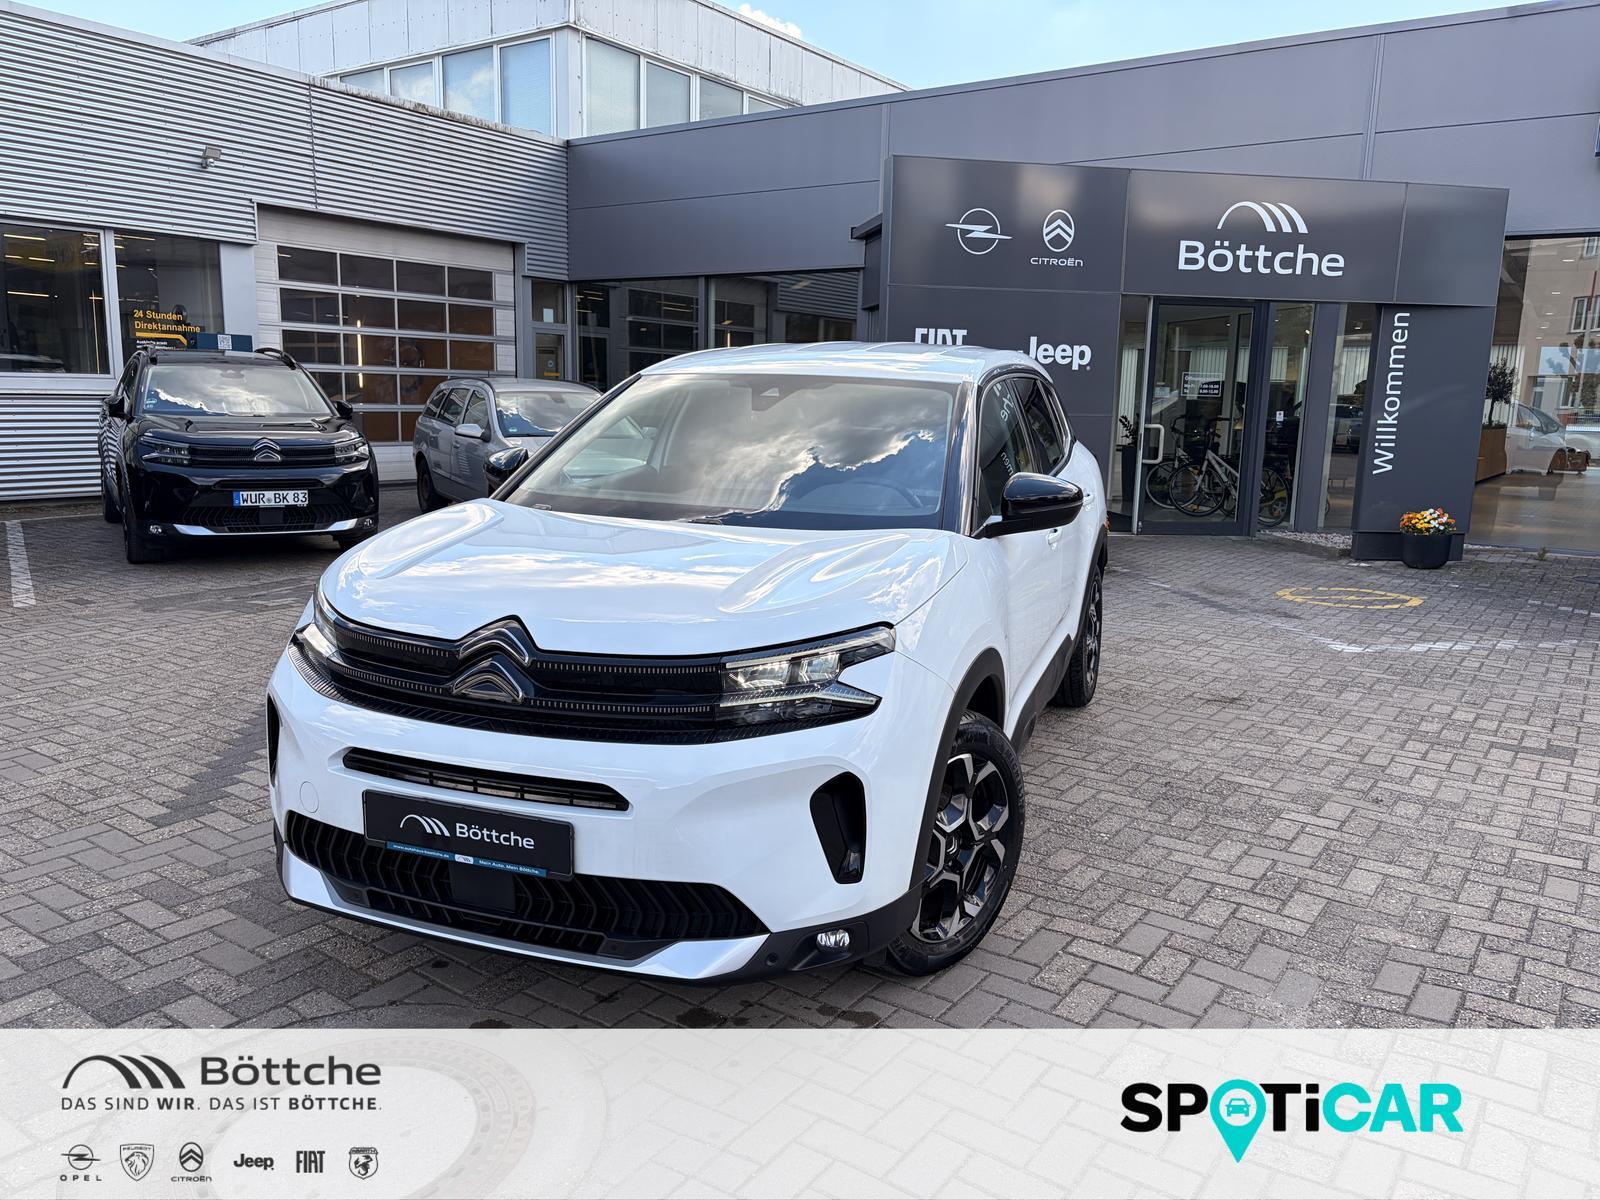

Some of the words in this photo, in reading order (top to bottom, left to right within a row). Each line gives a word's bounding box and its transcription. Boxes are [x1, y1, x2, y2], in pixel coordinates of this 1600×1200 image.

[1030, 257, 1083, 267] CITROËN
[1178, 240, 1344, 277] Böttche
[133, 309, 144, 318] 24
[146, 311, 183, 321] Stunden
[134, 321, 201, 333] Direktannahme
[1372, 311, 1410, 475] Willkommen
[241, 493, 266, 504] WUR
[274, 492, 289, 504] BK
[292, 492, 308, 503] 83
[455, 822, 535, 850] Böttche
